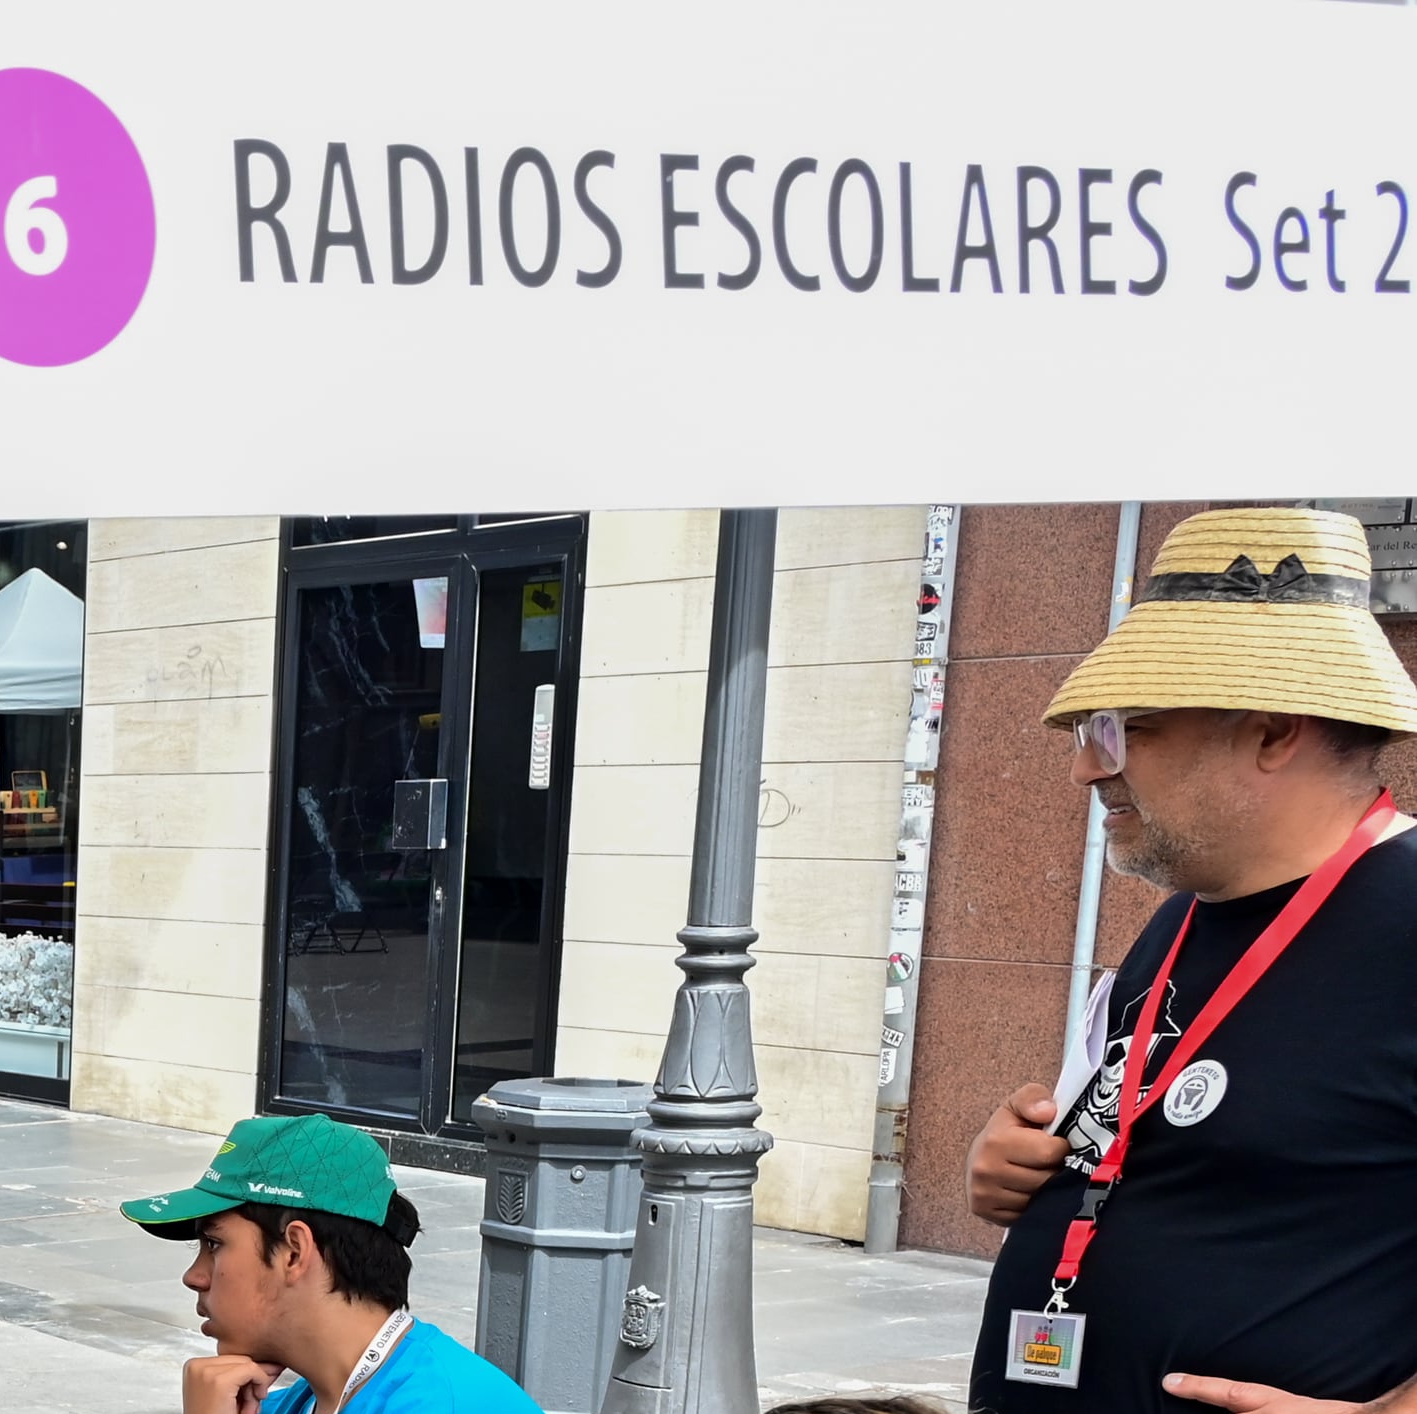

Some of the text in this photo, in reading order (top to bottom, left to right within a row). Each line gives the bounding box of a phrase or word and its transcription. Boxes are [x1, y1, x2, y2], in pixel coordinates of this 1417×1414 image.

[4, 175, 69, 276] 6
[234, 138, 1410, 296] RADIOS ESCOLARES Set 2
